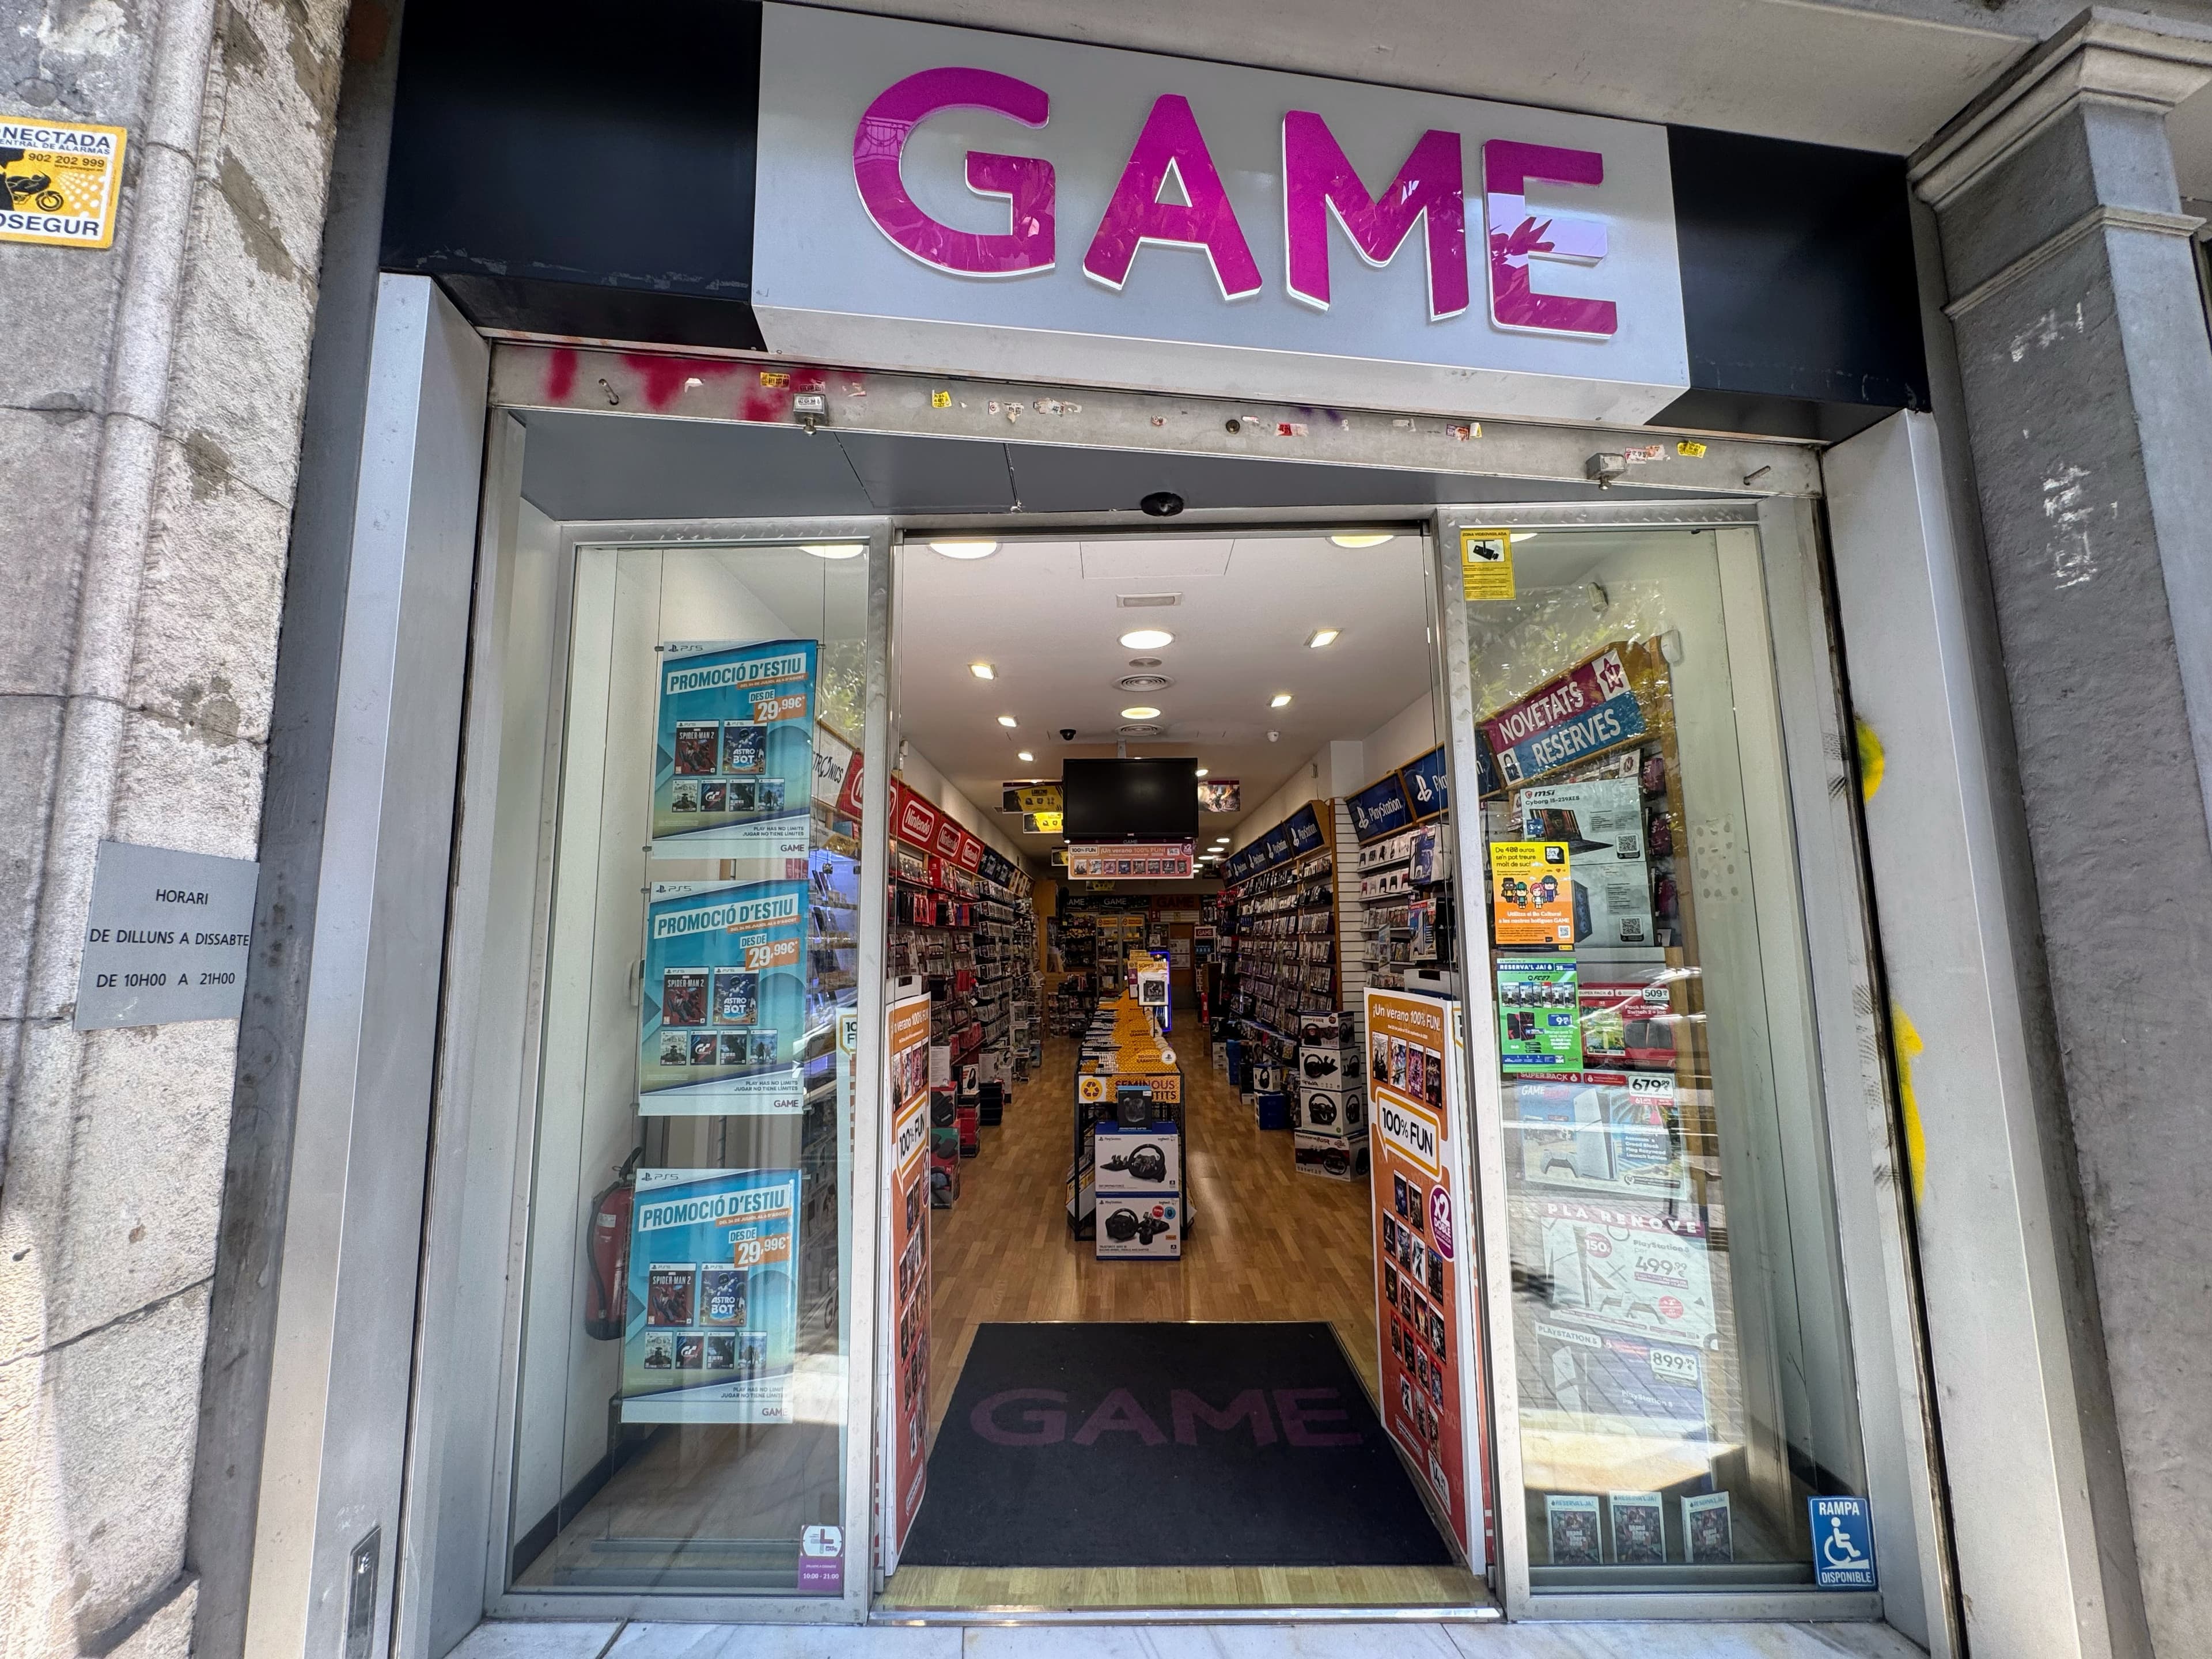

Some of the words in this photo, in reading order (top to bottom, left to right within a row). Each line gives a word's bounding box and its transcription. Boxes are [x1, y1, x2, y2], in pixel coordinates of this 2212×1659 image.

[0, 126, 111, 148] NECTADA
[59, 145, 110, 154] ALARMAS
[29, 153, 51, 162] 902
[55, 156, 78, 164] 202
[82, 158, 104, 168] 999
[853, 67, 1616, 339] GAME
[671, 664, 746, 691] PROMOCIÓ
[749, 657, 801, 678] D'ESTIU
[751, 692, 764, 702] DES
[764, 691, 774, 700] DE
[1498, 681, 1585, 745] NOVETATS
[1531, 708, 1622, 767] RESERVES
[733, 755, 755, 764] BOT
[1368, 797, 1403, 822] PlayStation
[905, 808, 931, 835] Nintendo
[940, 830, 959, 850] Nintendo
[1297, 823, 1317, 842] PlayStation
[963, 843, 978, 863] Nintendo
[156, 889, 209, 905] HORARI
[1157, 897, 1195, 908] GAME
[658, 904, 736, 935] PROMOCIÓ
[740, 899, 793, 922] D'ESTIU
[89, 929, 110, 942] DE
[116, 930, 174, 944] DILLUNS
[179, 932, 189, 945] A
[195, 933, 249, 946] DISSABTE
[741, 937, 755, 947] DES
[756, 935, 766, 944] DE
[96, 974, 117, 987] DE
[124, 974, 166, 986] 10H00
[177, 973, 188, 986] A
[200, 973, 235, 984] 21H00
[668, 979, 699, 987] SPIDER-MAN
[700, 979, 704, 987] 2
[724, 1005, 746, 1014] BOT
[1373, 1003, 1384, 1017] ¡Un
[1387, 1008, 1409, 1022] verano
[1411, 1010, 1426, 1027] 100%
[1426, 1014, 1440, 1032] FUN!
[1521, 1085, 1545, 1095] GAME
[774, 1100, 798, 1108] GAME
[899, 1125, 914, 1160] 100%
[915, 1113, 925, 1147] FUN
[1382, 1107, 1408, 1139] 100%
[1410, 1122, 1433, 1157] FUN
[643, 1195, 725, 1228] PROMOCIÓ
[728, 1190, 785, 1215] D'ESTIU
[1548, 1203, 1588, 1219] PLA
[1601, 1211, 1698, 1234] RENOVE
[730, 1230, 744, 1242] DES
[746, 1229, 756, 1239] DE
[1633, 1240, 1684, 1252] PlayStation
[653, 1276, 686, 1285] SPIDER-MAN
[687, 1276, 691, 1285] 2
[711, 1304, 735, 1314] BOT
[1539, 1325, 1591, 1343] PLAYSTATION
[1622, 1390, 1666, 1406] PlayStation
[762, 1408, 788, 1416] GAME
[970, 1387, 1364, 1447] GAME
[1819, 1501, 1861, 1517] RAMPA
[1821, 1571, 1873, 1585] DISPONIBLE
